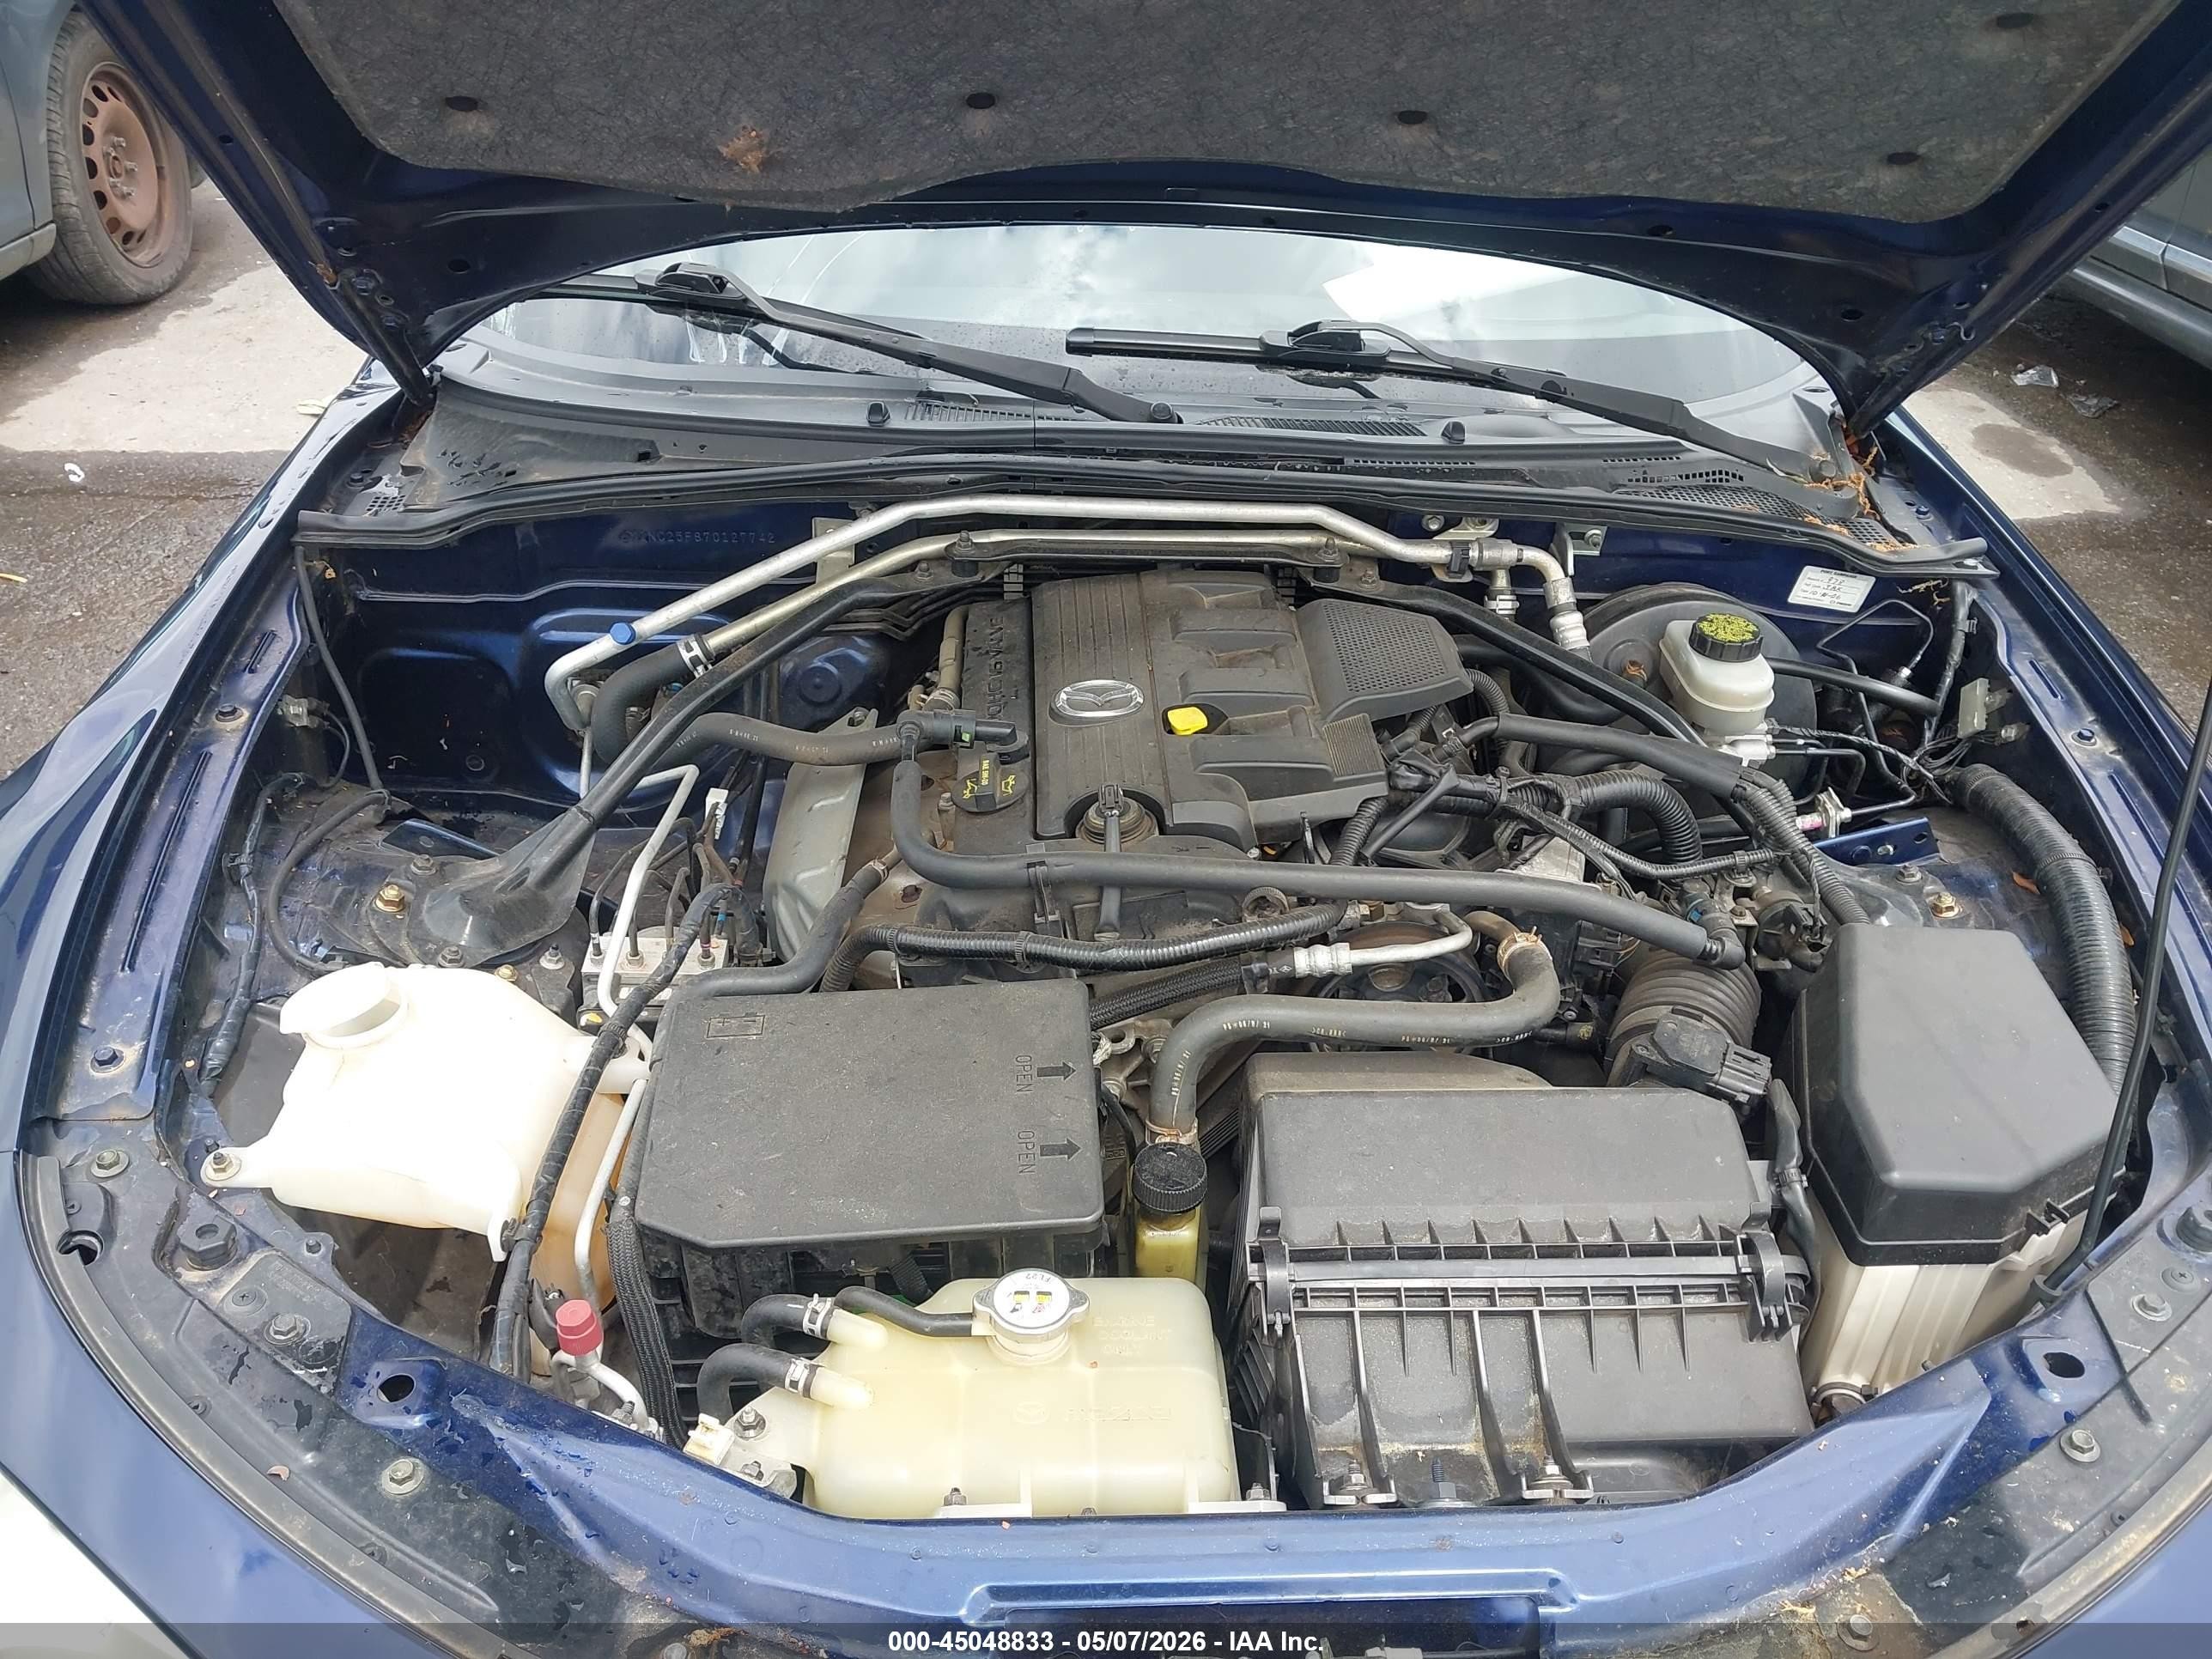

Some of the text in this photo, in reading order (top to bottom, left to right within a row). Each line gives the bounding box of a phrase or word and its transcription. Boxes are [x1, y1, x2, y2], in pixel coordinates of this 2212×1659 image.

[1016, 1054, 1033, 1092] OPEN
[1017, 1130, 1036, 1174] OPEN
[1025, 1273, 1051, 1283] FL22
[1093, 1315, 1155, 1327] ENGINE
[1098, 1328, 1173, 1340] COOLANT
[1100, 1345, 1142, 1355] ONLY
